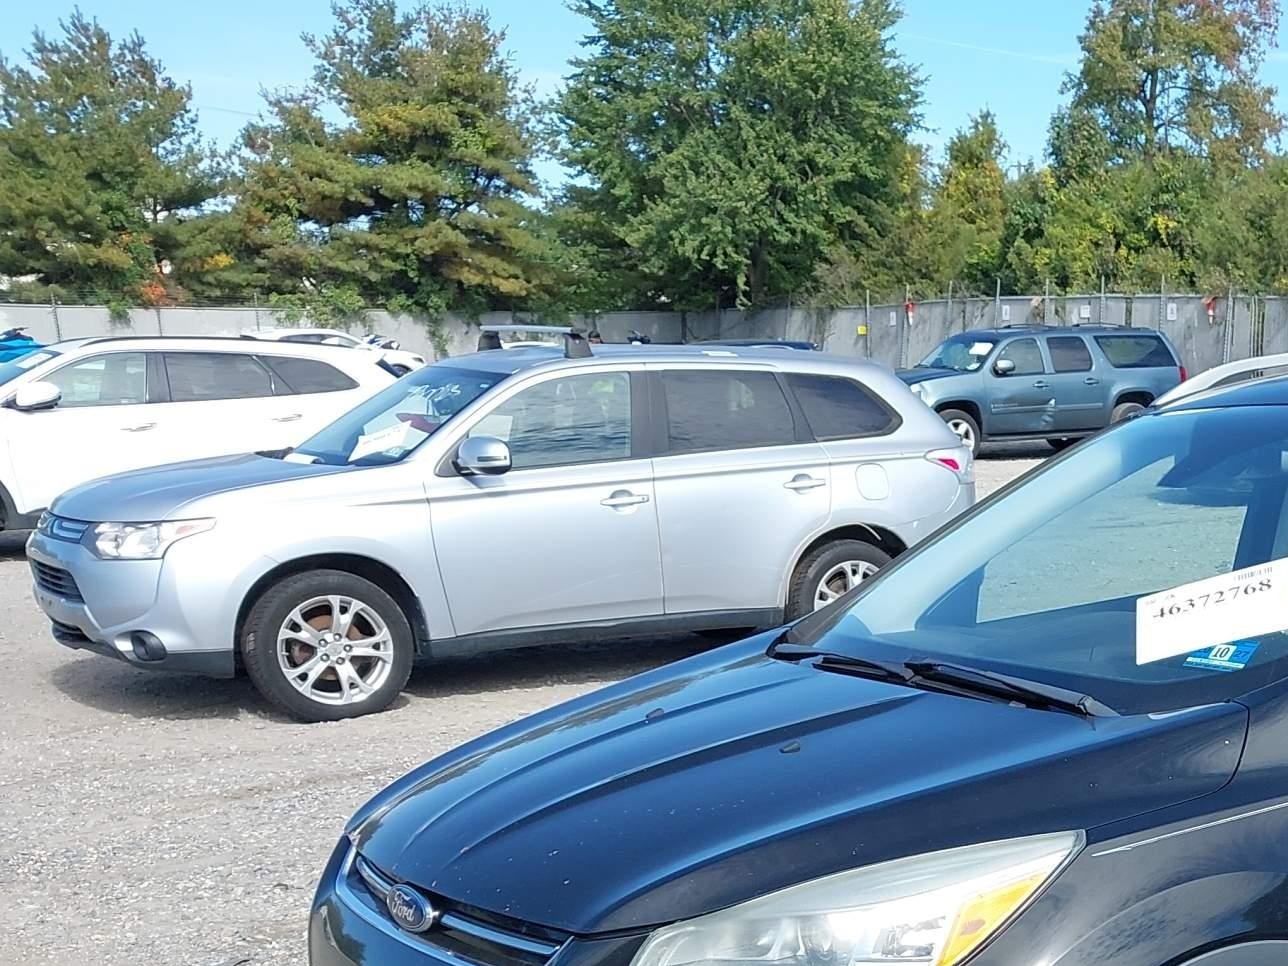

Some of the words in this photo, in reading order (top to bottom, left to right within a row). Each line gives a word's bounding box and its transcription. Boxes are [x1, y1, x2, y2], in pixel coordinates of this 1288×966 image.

[1153, 578, 1272, 618] 46372768
[1212, 646, 1230, 659] 10
[391, 889, 416, 922] Ford
